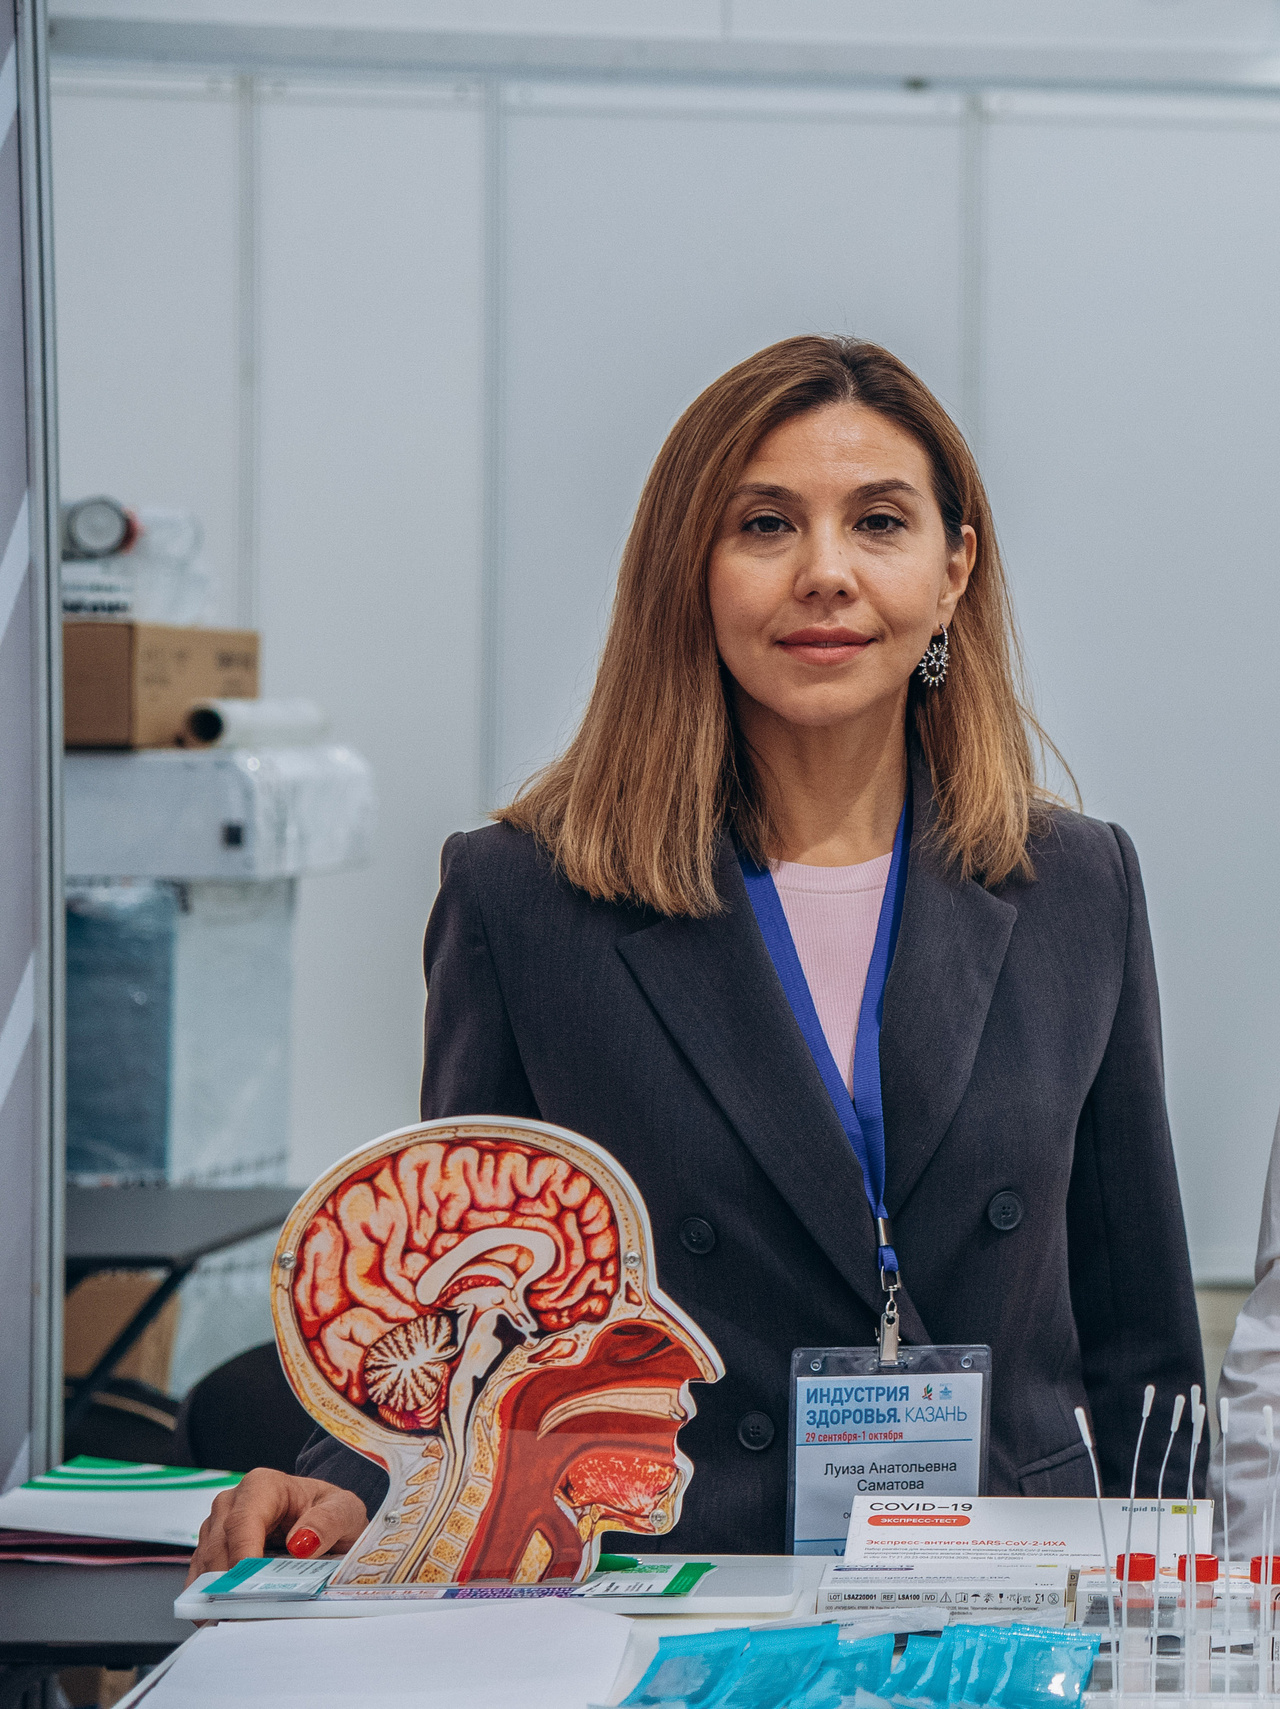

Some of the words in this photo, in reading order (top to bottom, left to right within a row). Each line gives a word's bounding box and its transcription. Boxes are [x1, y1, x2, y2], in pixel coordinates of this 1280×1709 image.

[806, 1385, 909, 1406] ИНДУСТРИЯ
[806, 1407, 901, 1429] ЗДОРОВЬЯ.
[905, 1405, 968, 1424] КАЗАНЬ
[805, 1432, 816, 1442] 29
[868, 1429, 904, 1442] октября
[824, 1463, 865, 1478] Луиза
[869, 1461, 957, 1475] Анатольевна
[857, 1478, 925, 1492] Саматова
[970, 1539, 1067, 1547] SARS-CoV-2-ИХА
